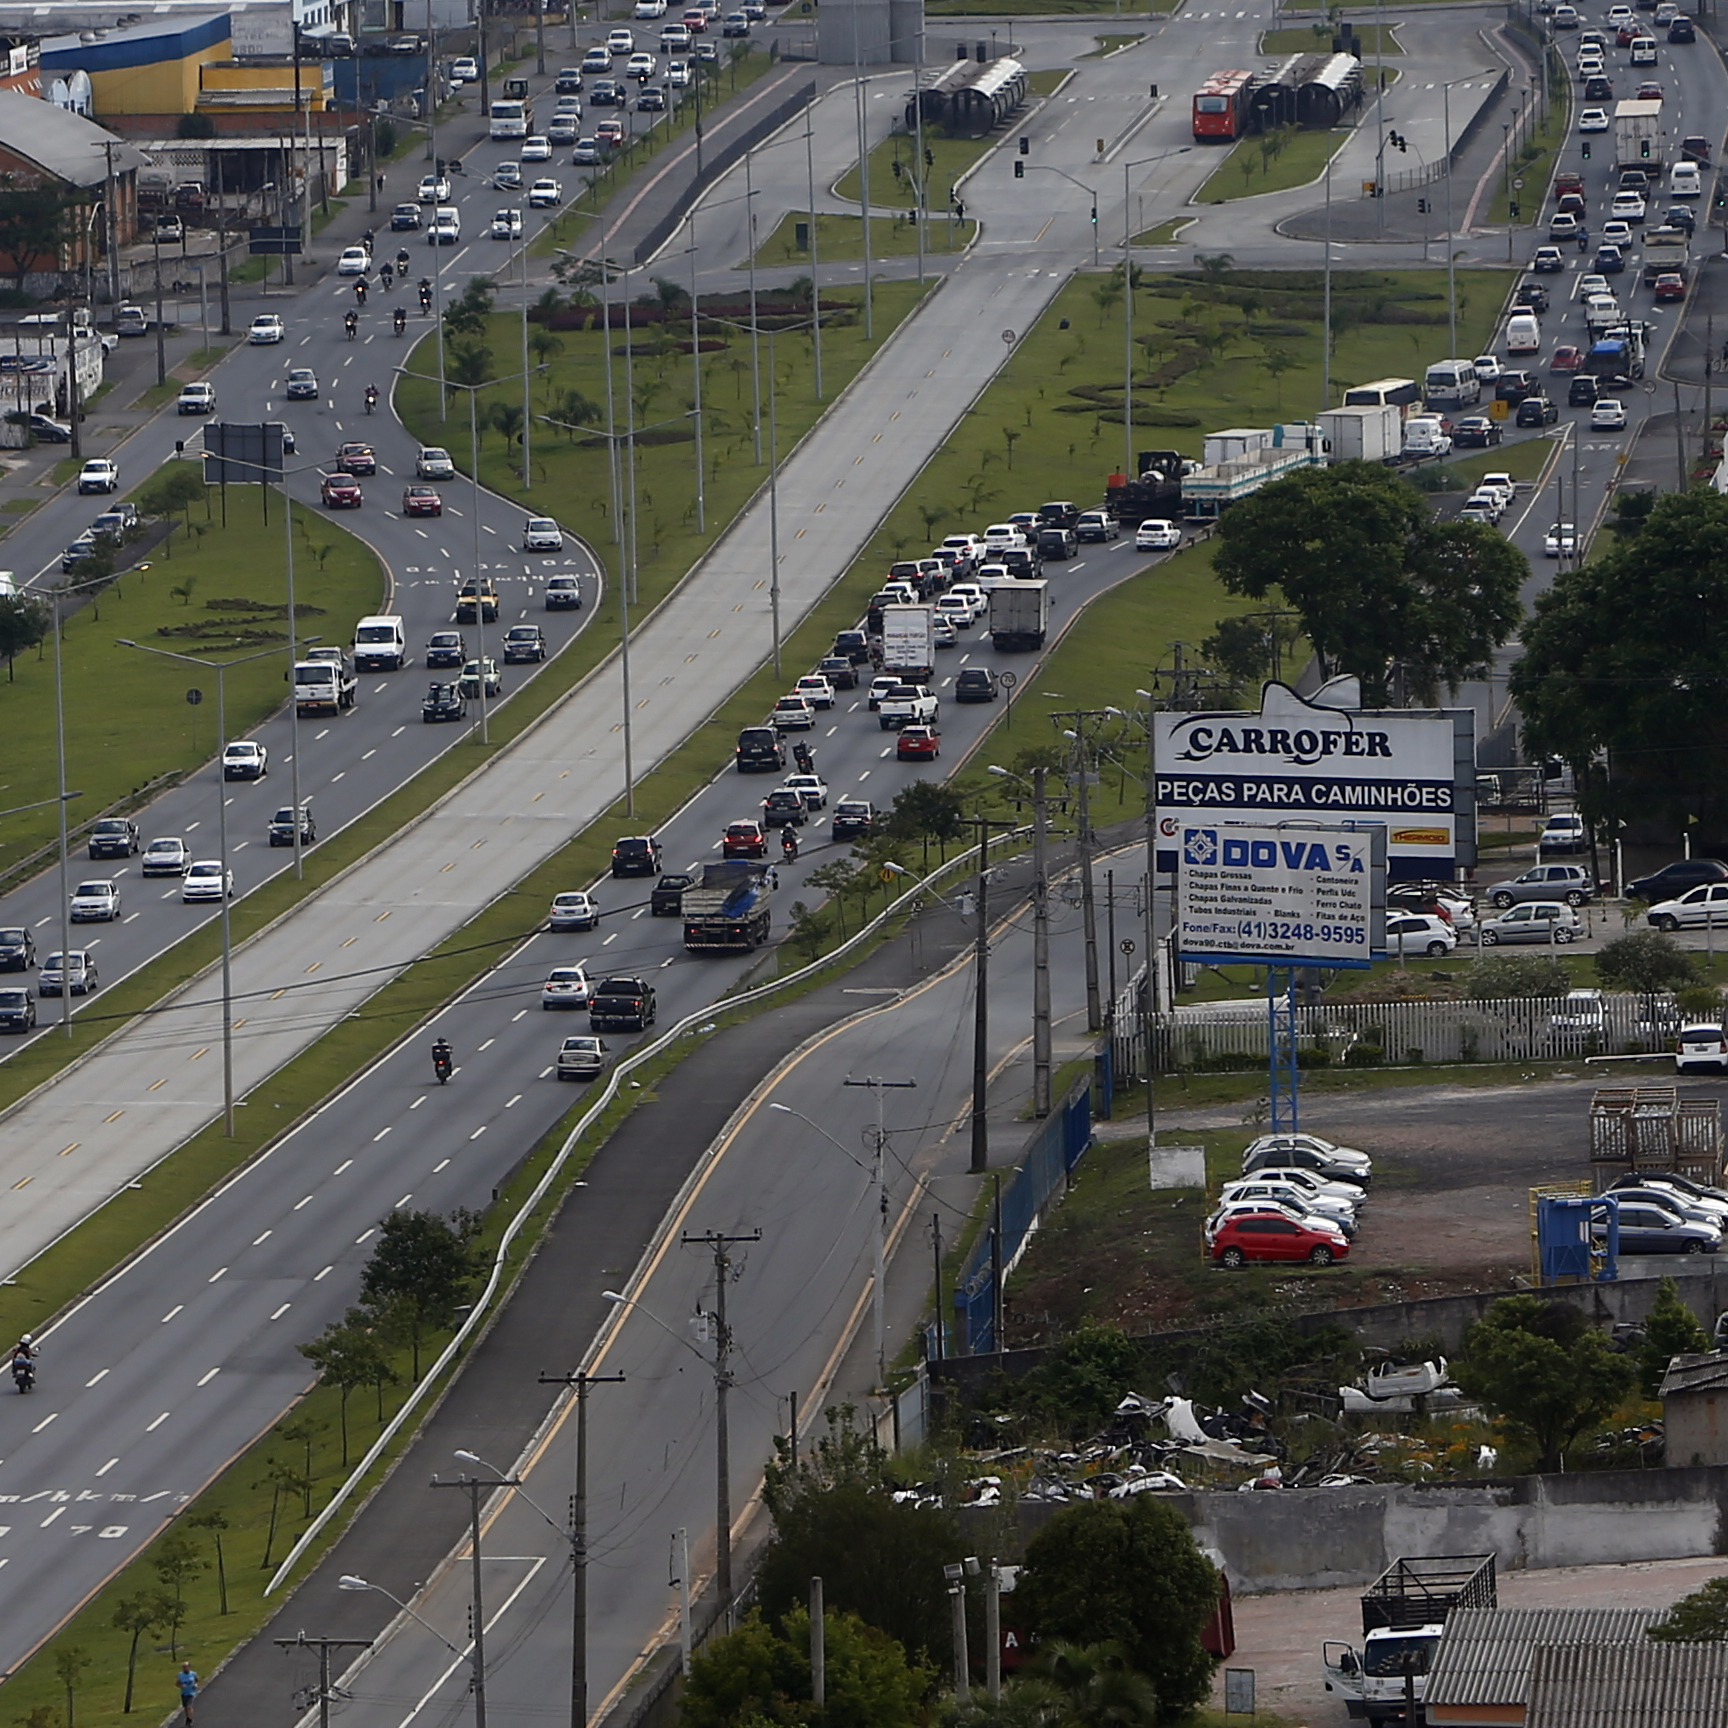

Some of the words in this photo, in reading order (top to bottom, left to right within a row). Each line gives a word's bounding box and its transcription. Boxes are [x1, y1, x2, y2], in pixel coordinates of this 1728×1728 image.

[1176, 727, 1393, 764] CARROFER
[1157, 780, 1236, 806] PEÇAS
[1243, 782, 1306, 804] PARA
[1310, 783, 1452, 808] CAMINHÕES
[1223, 838, 1332, 872] DOVA
[1189, 869, 1218, 880] Chapas
[1220, 870, 1252, 880] Grossas
[1316, 875, 1359, 886] Cantoneira
[1189, 881, 1218, 892] Chapas
[1220, 882, 1241, 892] Finas
[1251, 883, 1279, 894] Quente
[1288, 885, 1304, 895] Frio
[1189, 893, 1218, 904] Chapas
[1220, 895, 1272, 905] Galvanizadas
[1316, 899, 1337, 909] Ferro
[1339, 900, 1362, 910] Chato
[1189, 905, 1212, 915] Tubos
[1214, 906, 1257, 917] Industriais
[1274, 909, 1301, 919] Blanks
[1316, 911, 1337, 921] Fitas
[1338, 912, 1349, 922] de
[1350, 913, 1366, 923] Aço
[1183, 922, 1236, 934] Fone/Fax:
[1237, 920, 1366, 945] (41)3248-9595
[70, 1525, 129, 1539] 70
